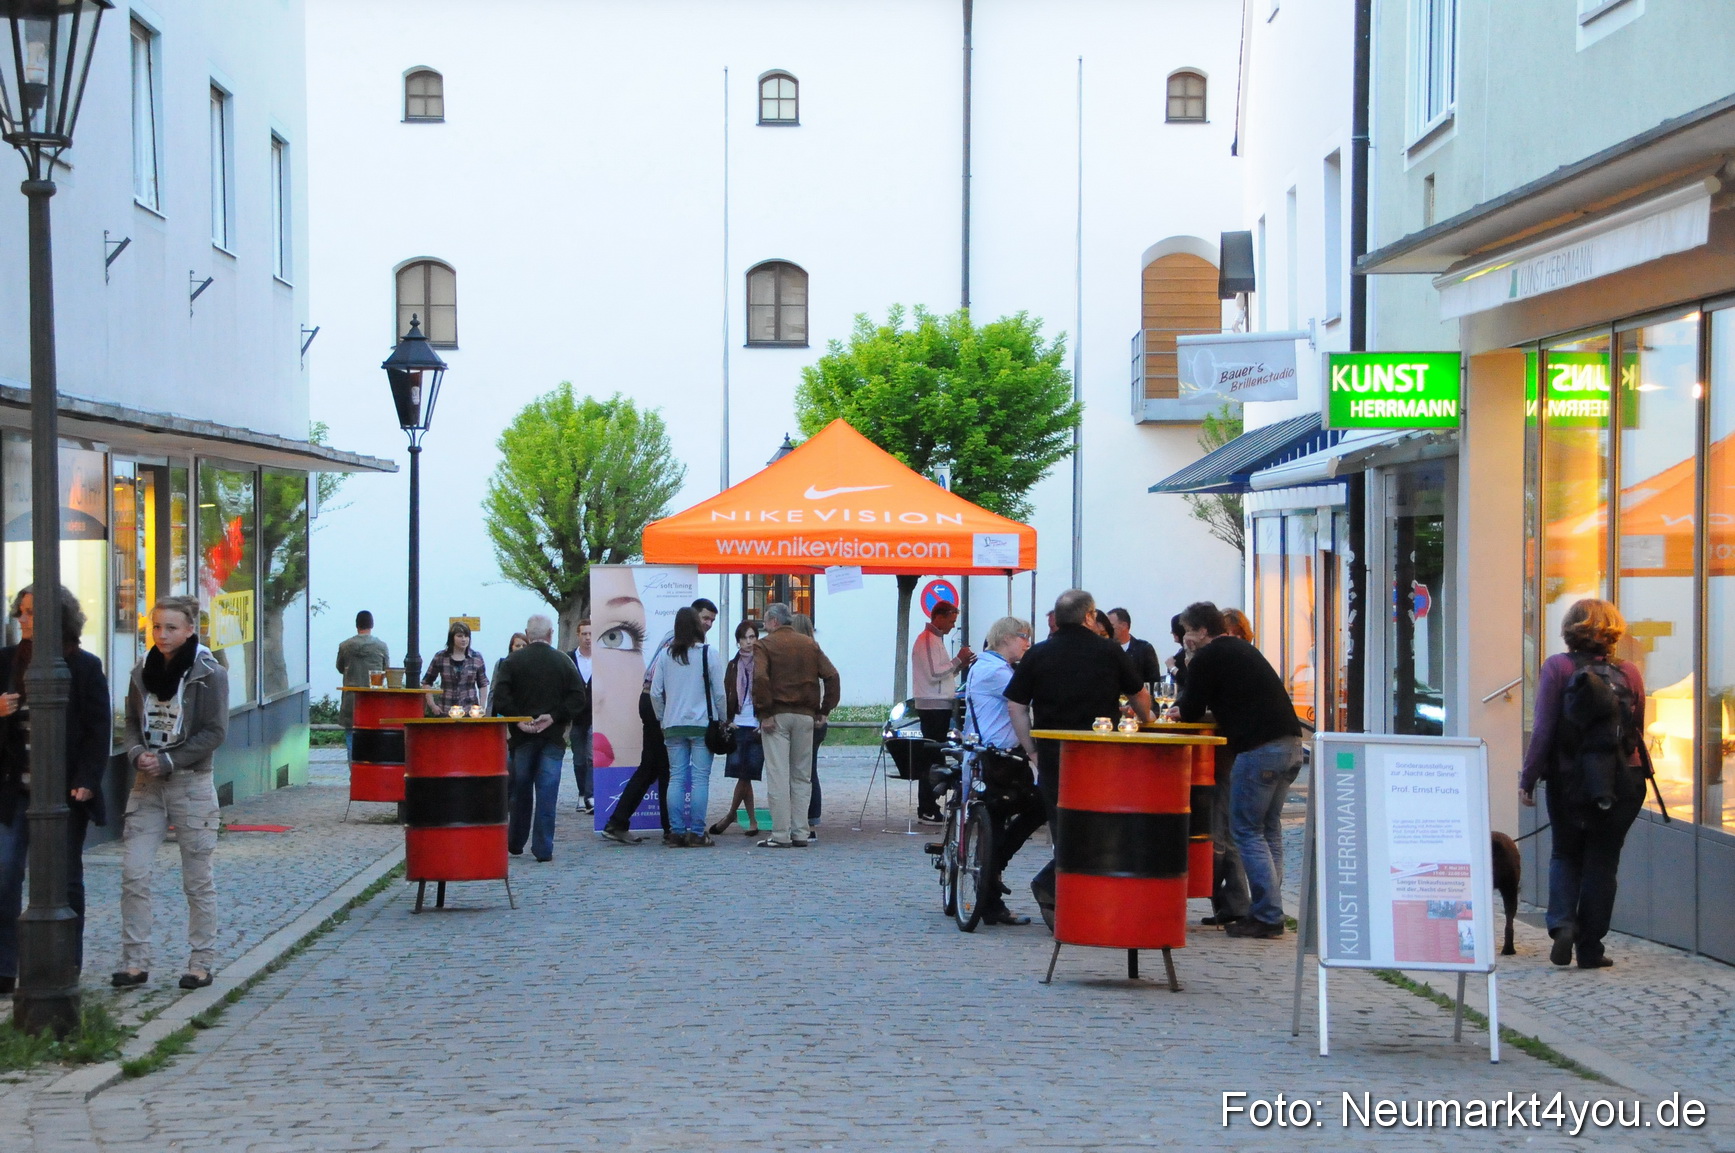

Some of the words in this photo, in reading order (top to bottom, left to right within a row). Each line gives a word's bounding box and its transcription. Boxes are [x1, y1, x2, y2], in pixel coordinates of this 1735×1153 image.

[1219, 362, 1265, 384] Bauer's
[1230, 367, 1295, 392] Brillenstudio
[1332, 363, 1429, 393] KUNST
[1350, 399, 1456, 418] HERRMANN
[716, 536, 951, 559] www.nikevision.com
[1395, 762, 1454, 770] Sonderausstellung
[1391, 785, 1410, 793] Prof.
[1412, 786, 1433, 794] Ernst
[1435, 786, 1460, 795] Fuchs
[1336, 773, 1357, 884] HERRMANN
[1338, 891, 1359, 955] KUNST
